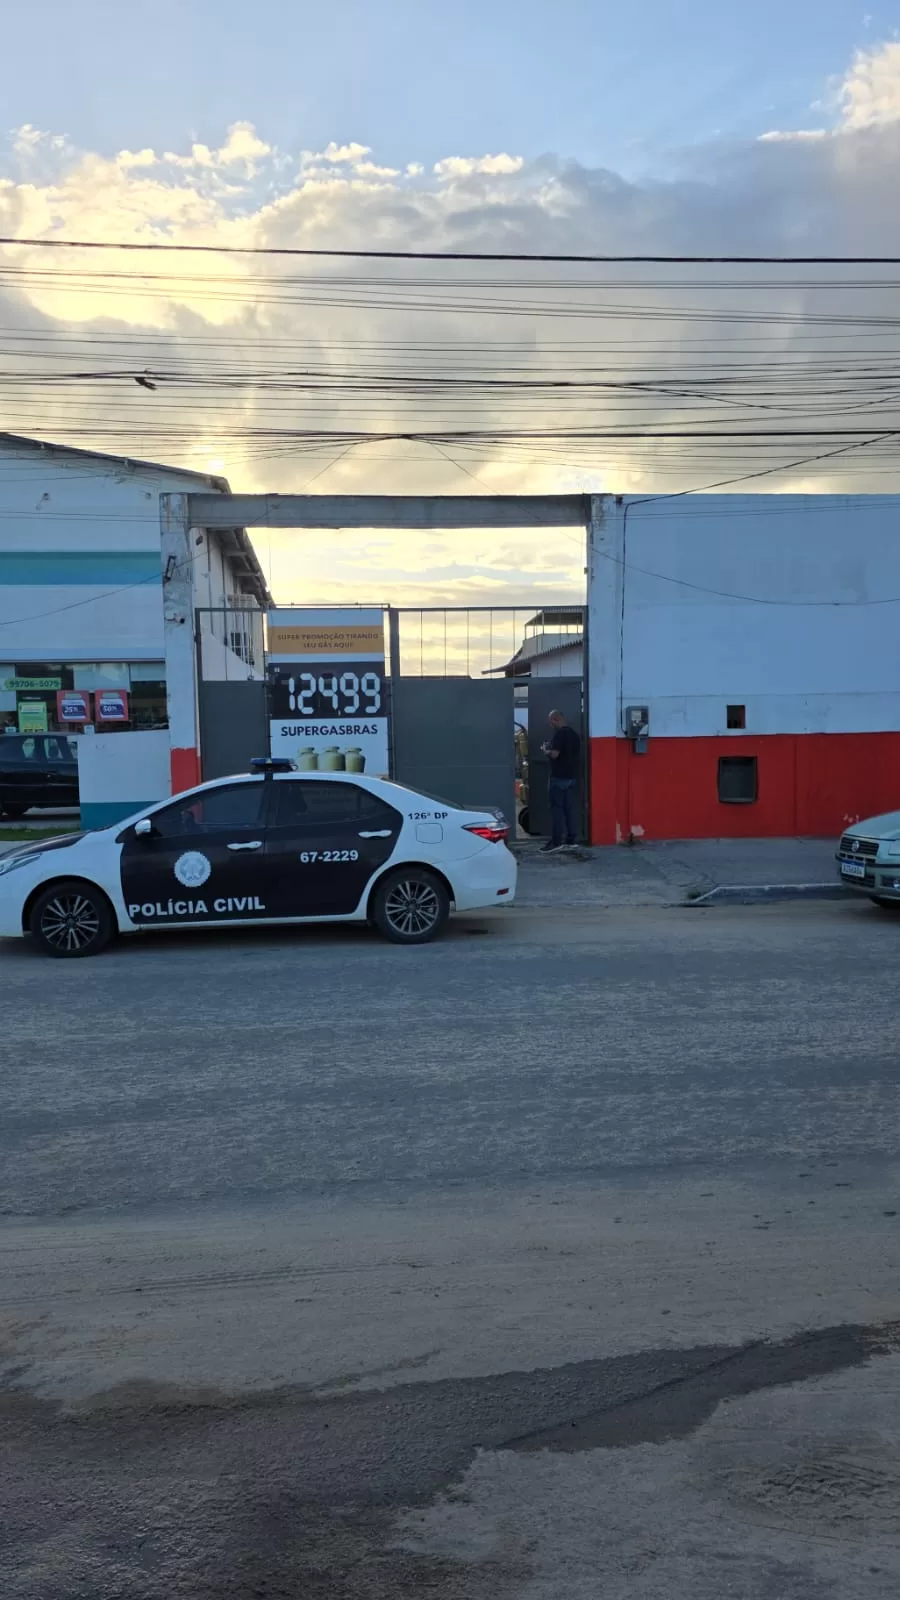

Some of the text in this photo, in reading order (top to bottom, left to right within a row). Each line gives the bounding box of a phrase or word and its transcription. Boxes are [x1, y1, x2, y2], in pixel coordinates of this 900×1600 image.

[277, 632, 379, 641] SUPER PROMOÇÃO TIRANDO
[281, 724, 378, 736] SUPERGASBRAS
[300, 850, 359, 863] 67-2229
[128, 896, 266, 917] POLÍCIA CIVIL
